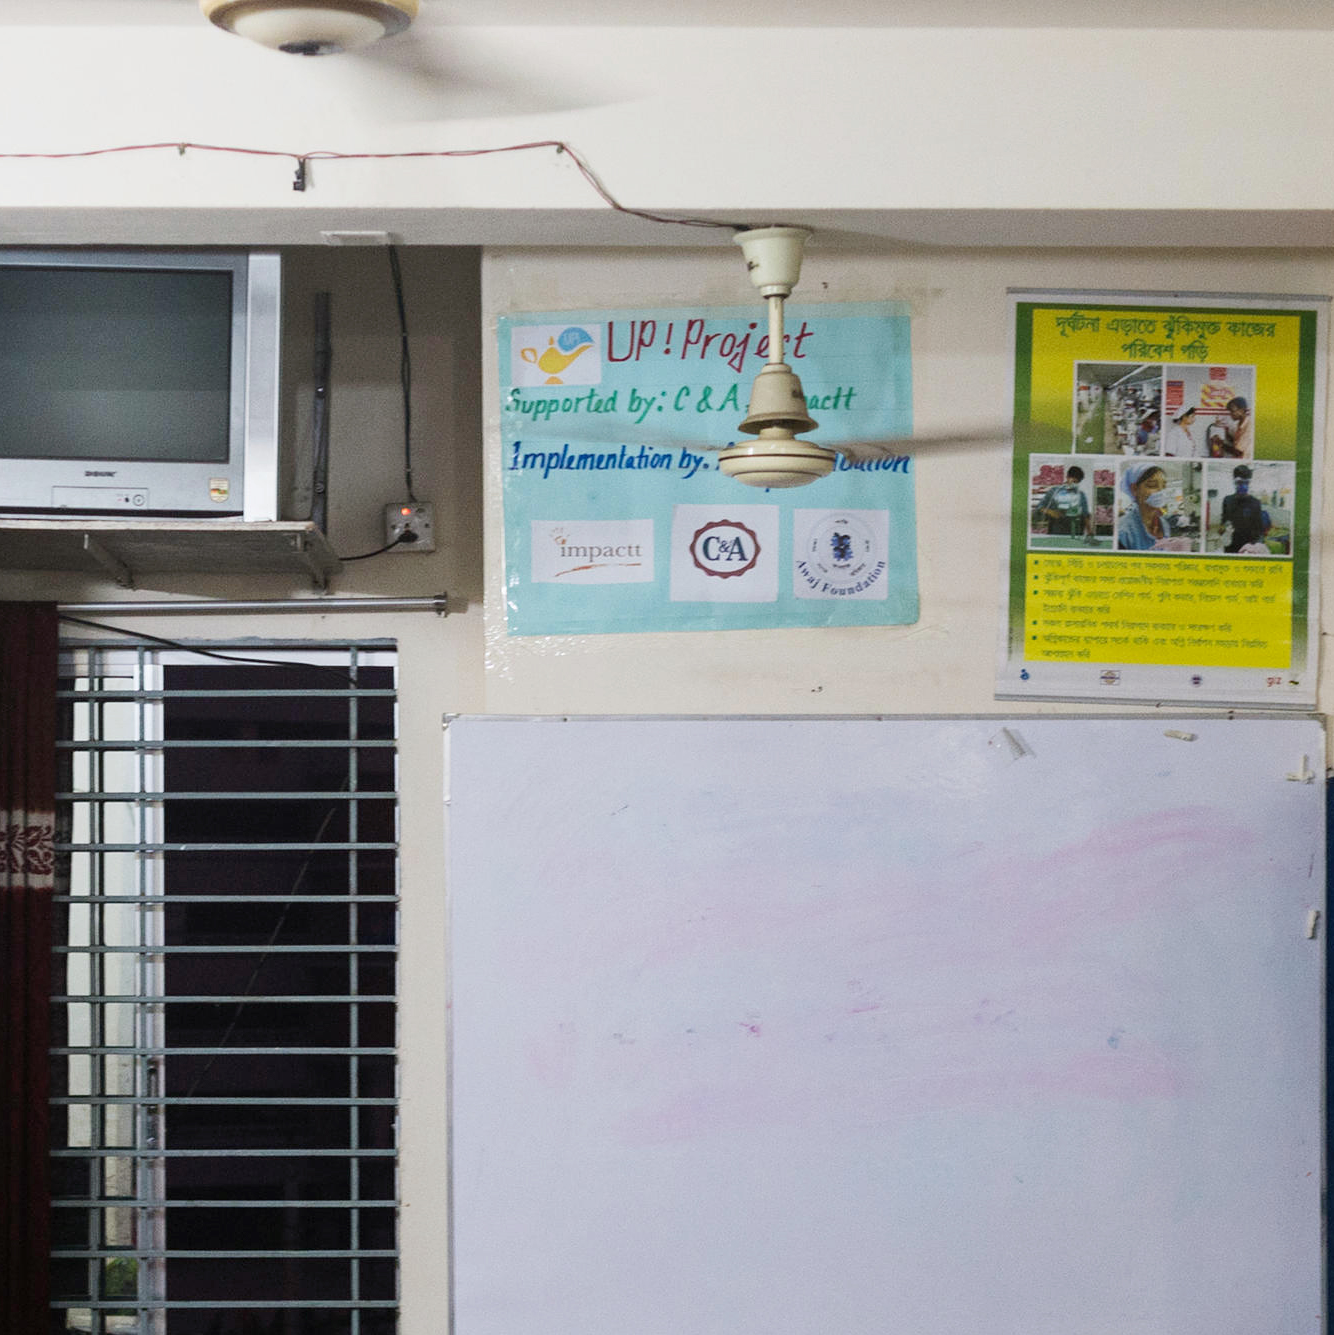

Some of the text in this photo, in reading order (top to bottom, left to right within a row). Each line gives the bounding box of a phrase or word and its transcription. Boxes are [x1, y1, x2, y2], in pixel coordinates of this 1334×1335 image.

[608, 320, 673, 362] UP!
[506, 388, 617, 421] Supported
[628, 388, 665, 424] by:
[674, 385, 690, 412] C
[698, 389, 713, 413] &
[804, 386, 857, 411] actt
[509, 442, 672, 479] Implementation
[561, 544, 642, 562] impactt
[702, 535, 748, 562] C&A
[822, 561, 886, 595] Foundation
